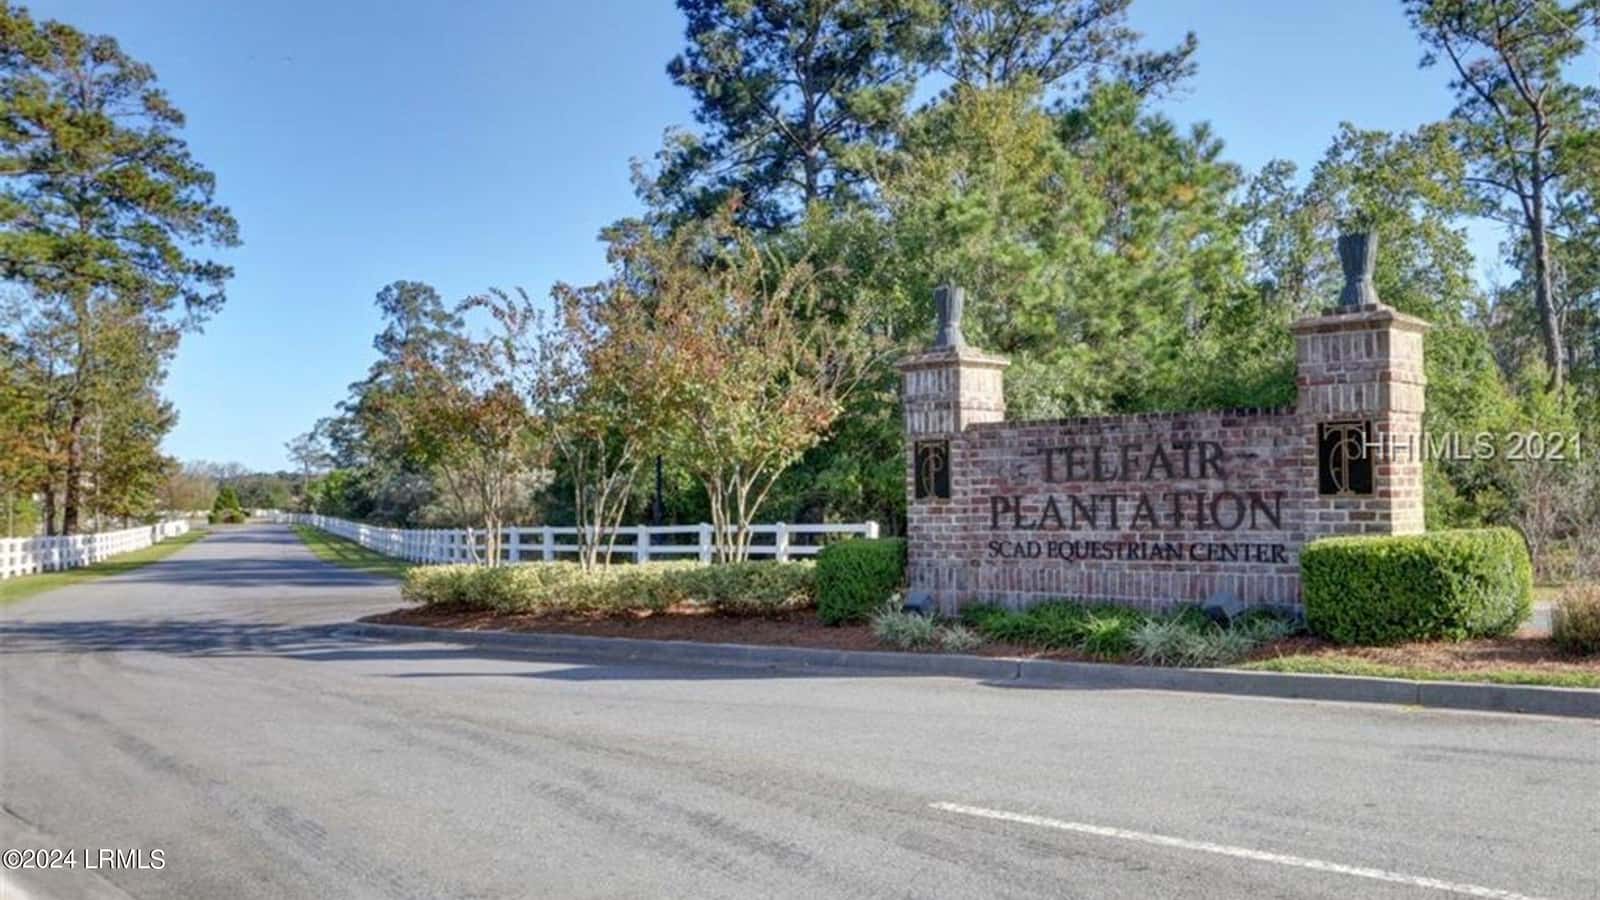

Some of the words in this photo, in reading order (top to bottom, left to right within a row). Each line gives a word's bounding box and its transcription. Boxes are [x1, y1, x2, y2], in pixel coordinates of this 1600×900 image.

[1035, 442, 1225, 482] TELFAIR
[990, 491, 1284, 531] PLANTATION
[988, 541, 1042, 560] SCAD
[1048, 541, 1184, 562] EQUESTRIAN
[1189, 542, 1289, 564] CENTER
